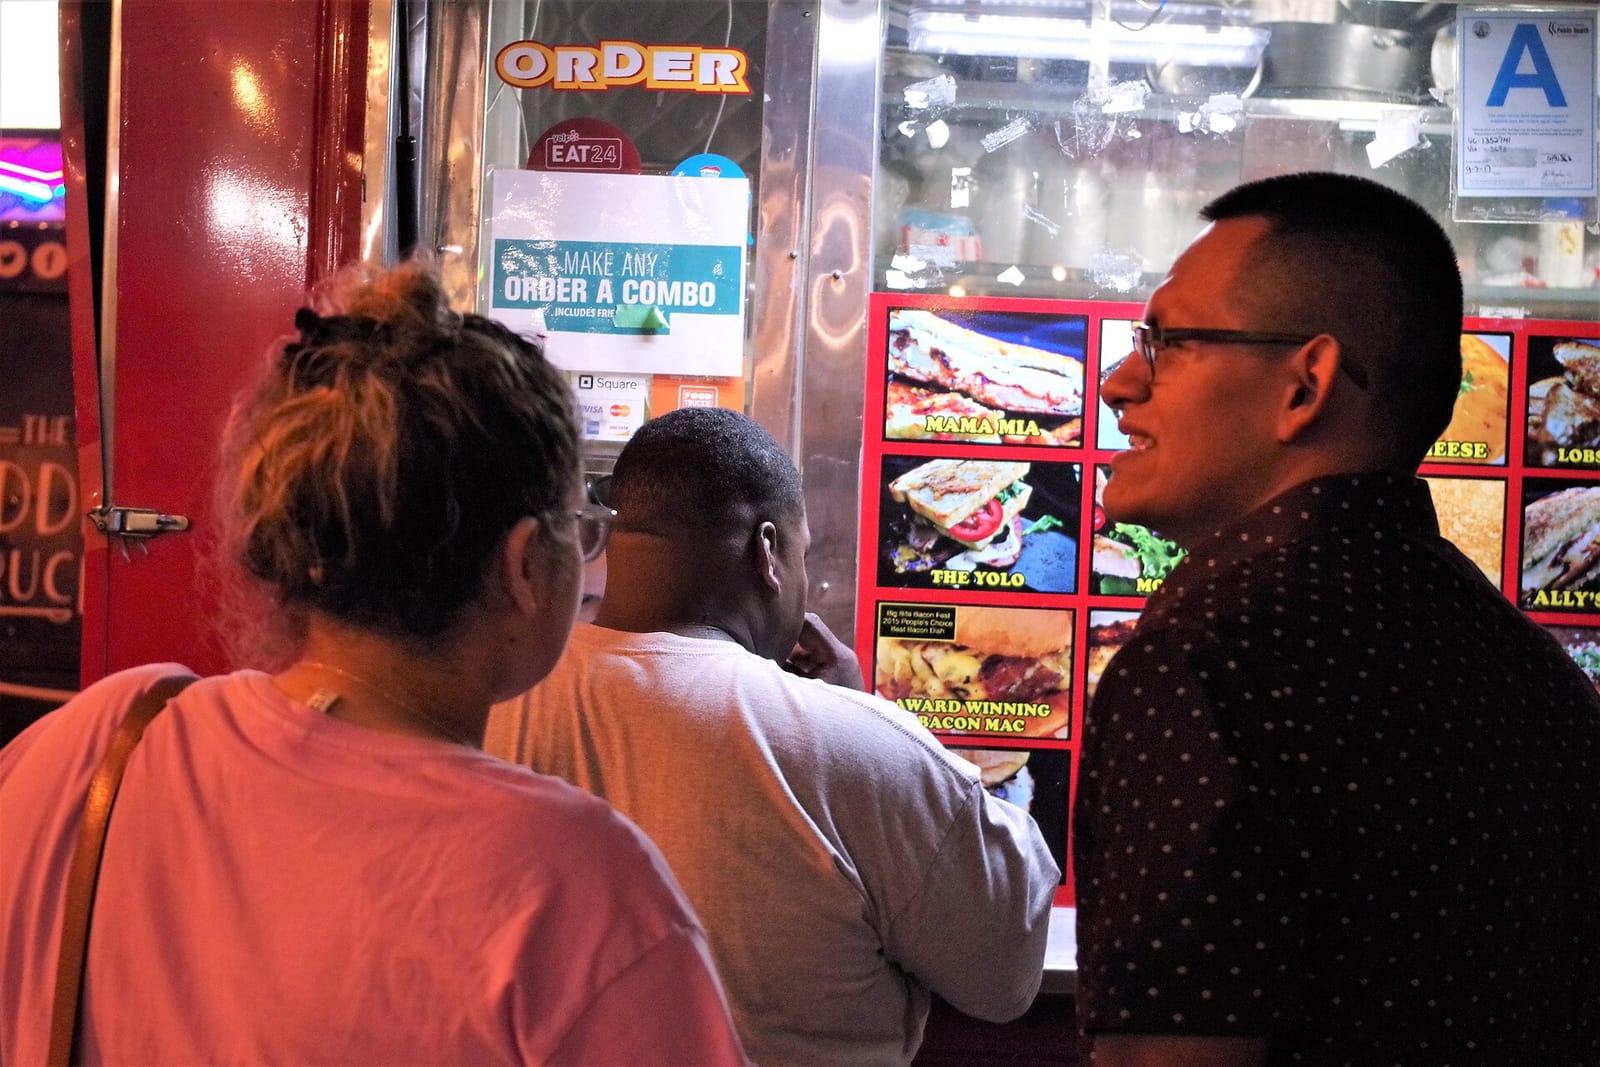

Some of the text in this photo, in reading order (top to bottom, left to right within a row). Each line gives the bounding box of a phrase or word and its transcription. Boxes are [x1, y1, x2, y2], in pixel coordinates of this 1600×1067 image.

[498, 42, 749, 91] ORDER
[1486, 23, 1568, 107] A
[551, 144, 617, 163] EAT24
[564, 250, 658, 278] MAKE ANY
[504, 275, 717, 308] ORDER A COMBO
[554, 306, 596, 318] INCLUDES
[596, 376, 637, 391] Square
[24, 414, 72, 445] THE
[925, 414, 1041, 436] MAMA MIA
[931, 569, 1026, 588] THE YOLO
[882, 617, 953, 627] 2015 People's Choice
[913, 610, 935, 618] Bacon
[896, 698, 1051, 717] AWARD WINNING
[918, 715, 1026, 732] BACON MAC
